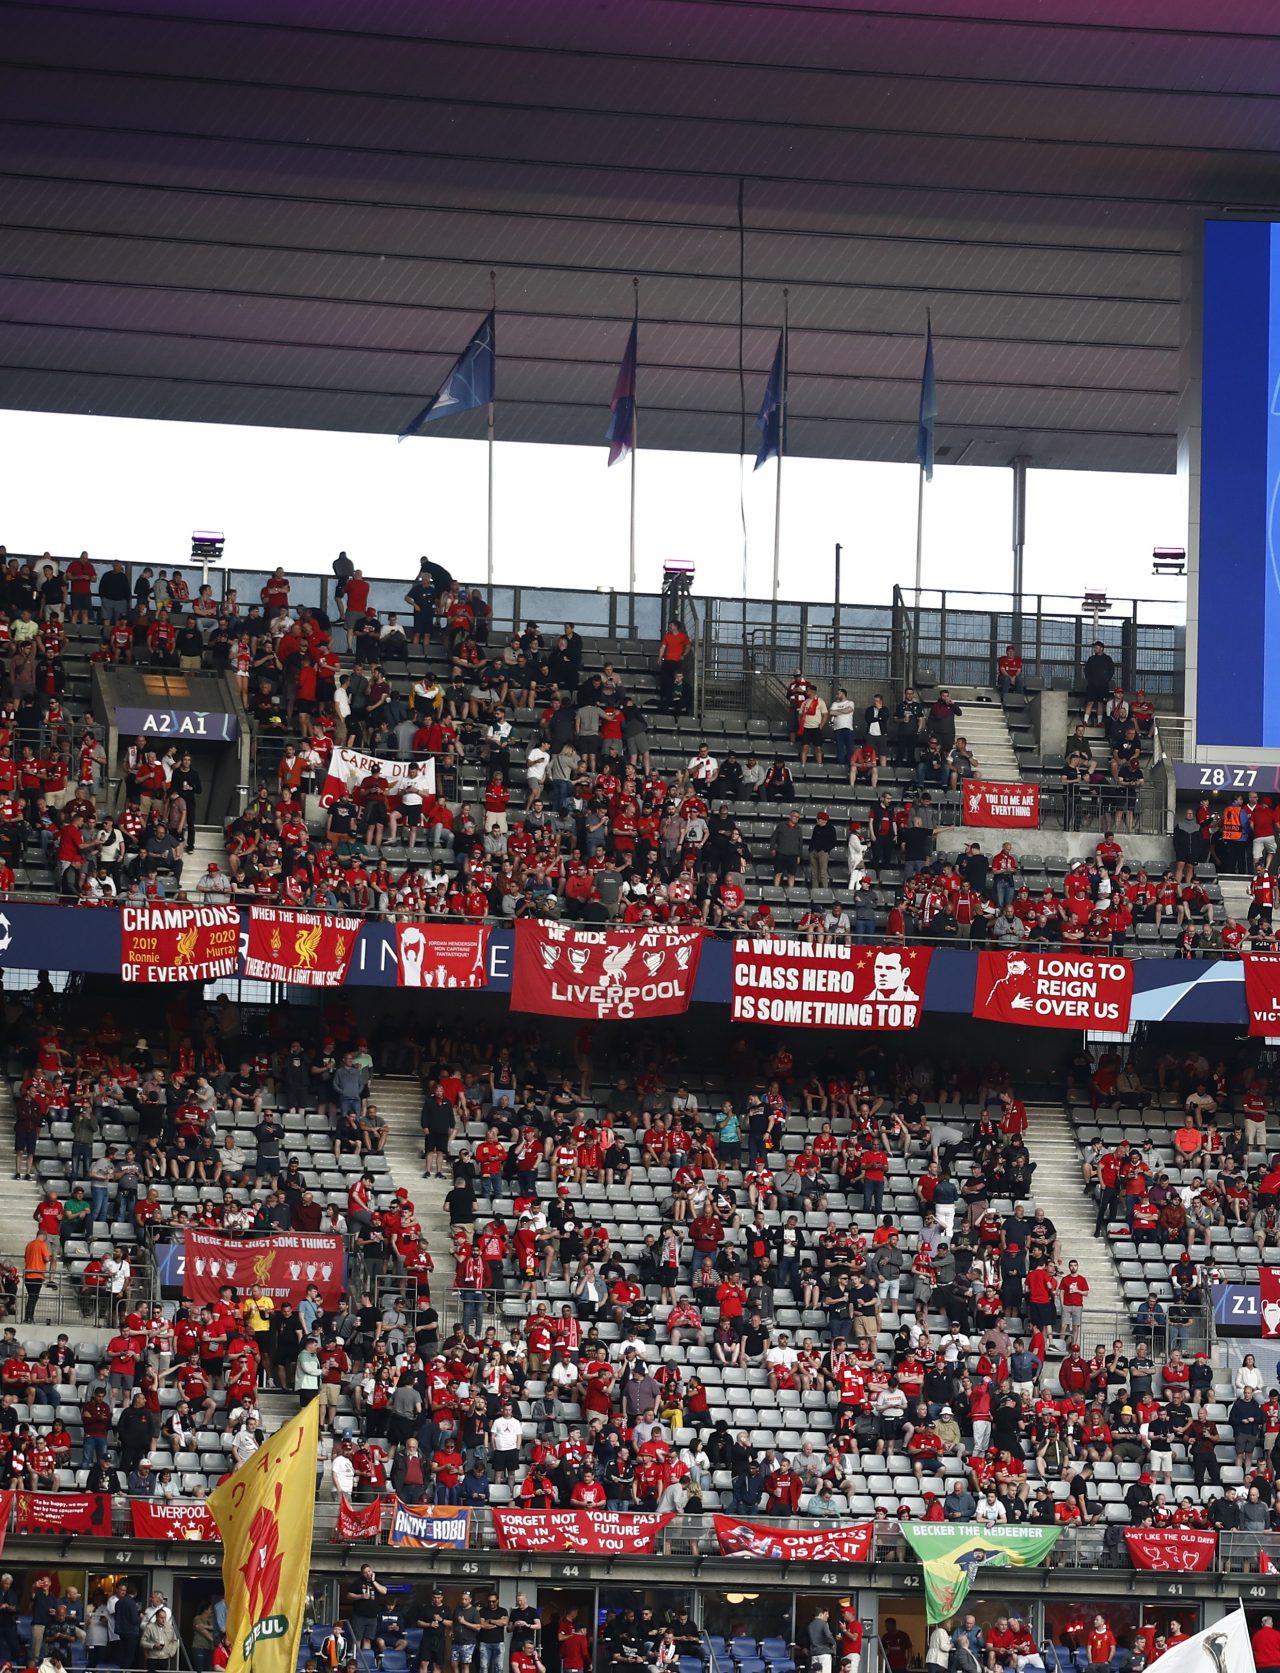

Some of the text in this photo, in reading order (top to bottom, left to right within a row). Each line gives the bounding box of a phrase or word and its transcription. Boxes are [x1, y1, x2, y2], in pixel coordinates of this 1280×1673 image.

[143, 712, 207, 735] A2 A1
[1200, 767, 1257, 787] Z8 Z7
[985, 793, 1034, 805] YOU TO ME ARE
[991, 805, 1030, 817] EVERYTHING
[123, 906, 240, 931] CHAMPIONS
[251, 906, 333, 928] WHEN THE NIGHT IS
[132, 937, 158, 950] 2019
[210, 929, 236, 945] 2020
[639, 934, 661, 946] AT
[129, 951, 160, 963] Ronnie
[206, 945, 237, 958] Murray
[122, 963, 141, 981] OF
[245, 957, 325, 985] THERE IS STILL A LIGHT THAT
[1037, 959, 1126, 982] LONG TO
[735, 963, 854, 993] CLASS HERO
[552, 980, 685, 1003] LIVERPOOL
[1036, 978, 1097, 998] REIGN
[734, 996, 900, 1027] IS SOMETHING TO
[1035, 997, 1119, 1021] OVER US
[245, 1239, 270, 1248] JUST
[272, 1236, 299, 1248] SOME
[301, 1237, 336, 1249] THINGS
[276, 1287, 291, 1298] BUY
[150, 1504, 209, 1519] LIVERPOOL
[500, 1511, 662, 1526] FORGET NOT YOUR PAST
[433, 1519, 466, 1540] ROBO
[503, 1526, 526, 1535] FOR
[535, 1527, 548, 1536] IN
[594, 1524, 640, 1536] FUTURE
[913, 1525, 1043, 1538] BECKER THE REDEEMER
[1125, 1531, 1142, 1541] JUST
[1143, 1532, 1161, 1541] LIKE
[1163, 1533, 1178, 1541] THE
[1181, 1533, 1196, 1542] OLD
[507, 1535, 623, 1549] IT MAY YOU
[783, 1535, 823, 1546] ONE
[116, 1552, 132, 1562] 47
[790, 1548, 808, 1558] IS
[844, 1542, 860, 1555] IT
[200, 1554, 216, 1565] 46
[462, 1563, 478, 1573] 45
[562, 1566, 579, 1576] 44
[821, 1573, 837, 1584] 43
[904, 1576, 920, 1586] 42
[1168, 1584, 1183, 1594] 41
[1250, 1586, 1266, 1597] 40
